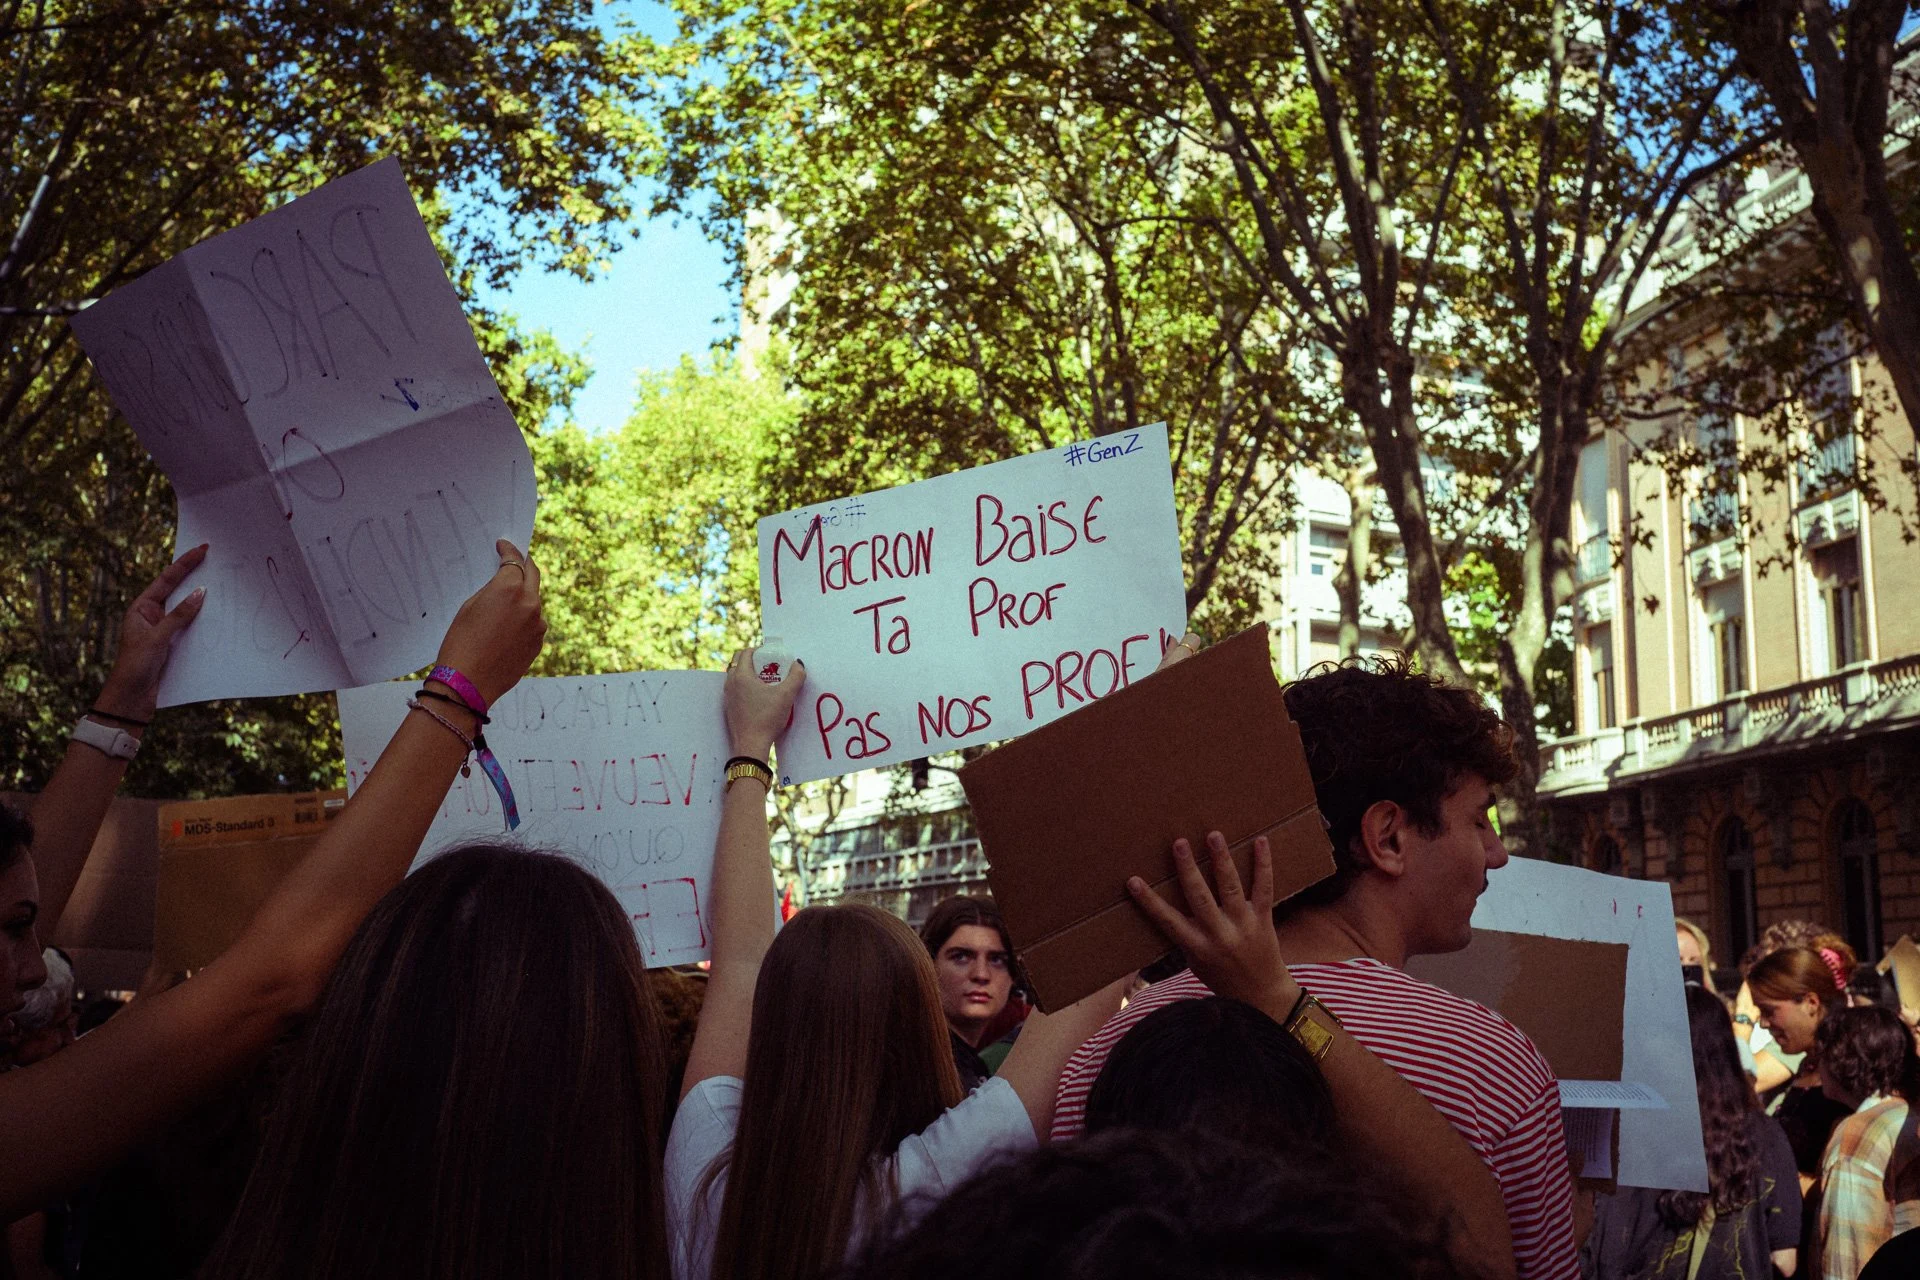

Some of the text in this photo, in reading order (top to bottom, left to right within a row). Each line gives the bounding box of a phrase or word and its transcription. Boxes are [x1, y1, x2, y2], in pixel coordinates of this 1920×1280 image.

[1063, 433, 1144, 466] #GenZ
[853, 596, 911, 655] Ta
[184, 818, 265, 836] MDS-Standard
